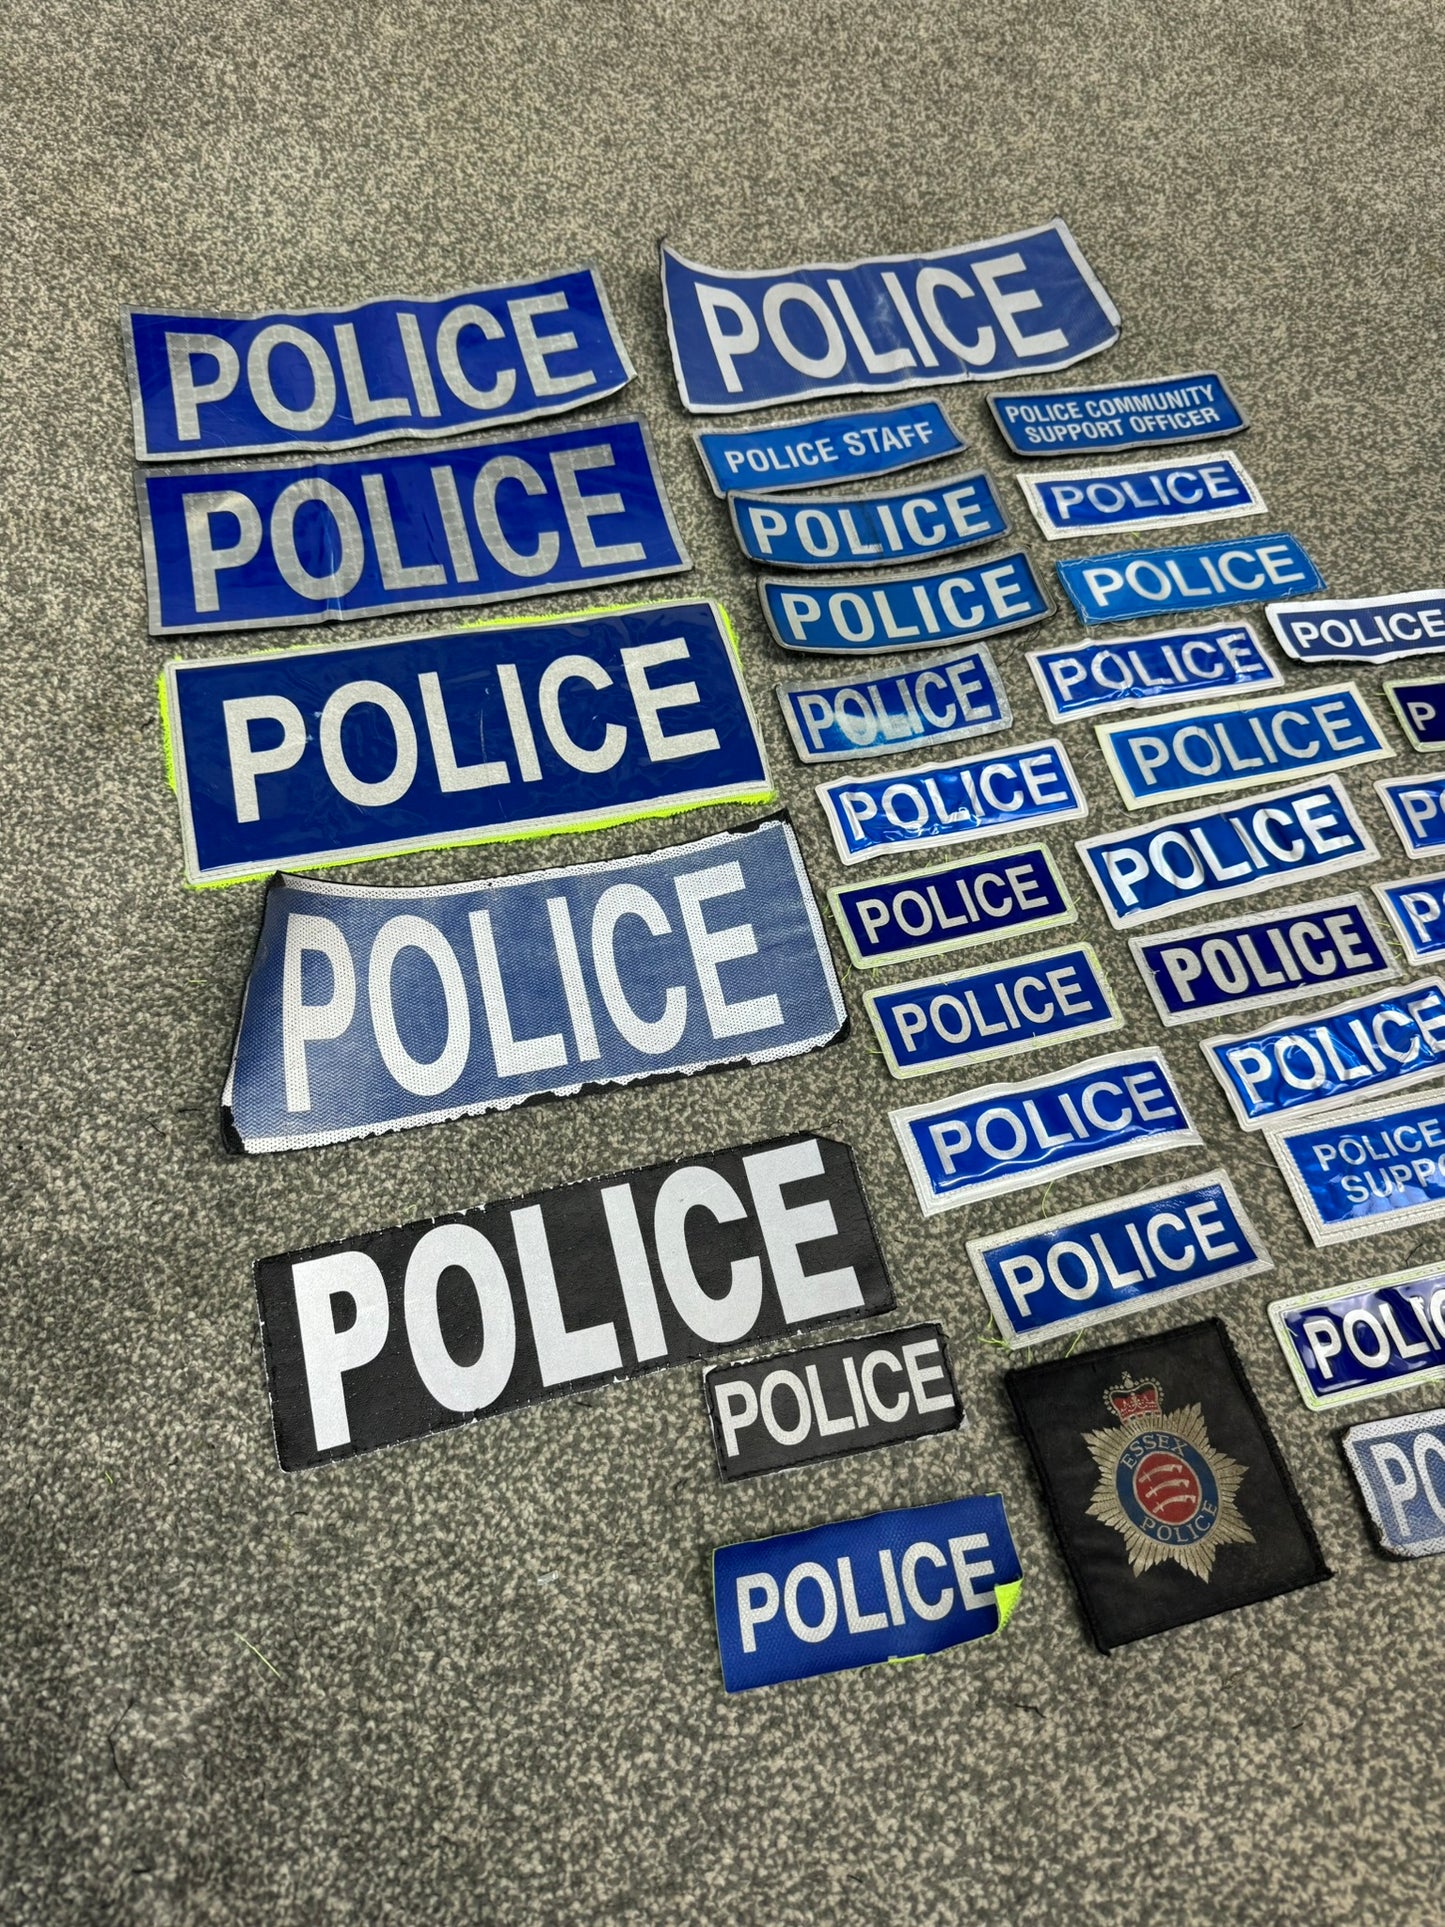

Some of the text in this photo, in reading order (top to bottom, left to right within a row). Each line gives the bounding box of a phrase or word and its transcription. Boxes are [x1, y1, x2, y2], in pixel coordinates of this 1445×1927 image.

[694, 252, 1070, 393] POLICE
[164, 292, 597, 441] POLICE
[1004, 384, 1215, 424] POLICE COMMUNITY
[724, 421, 934, 475] POLICE STAFF
[1024, 407, 1221, 444] SUPPORT OFFICER
[182, 444, 646, 613] POLICE
[748, 486, 992, 556] POLICE
[1050, 466, 1240, 519] POLICE
[780, 564, 1032, 640] POLICE
[1083, 544, 1305, 607] POLICE
[1048, 632, 1264, 702] POLICE
[1290, 609, 1445, 648] POLICE
[222, 637, 721, 823] POLICE
[797, 658, 993, 753] POLICE
[1127, 700, 1366, 786] POLICE
[838, 753, 1070, 841] POLICE
[1101, 793, 1355, 906] POLICE
[855, 863, 1050, 944] POLICE
[283, 860, 786, 1113] POLICE
[1160, 913, 1373, 1003] POLICE
[891, 966, 1093, 1052] POLICE
[1228, 995, 1445, 1104] POLICE
[928, 1071, 1177, 1175] POLICE
[1312, 1118, 1445, 1172] POLICE
[1340, 1153, 1445, 1203] SUPP
[290, 1139, 867, 1453] POLICE
[999, 1200, 1240, 1317] POLICE
[713, 1339, 956, 1457] POLICE
[1120, 1433, 1188, 1470] ESSEX
[1139, 1499, 1217, 1543] POLICE
[738, 1532, 999, 1654] POLICE
